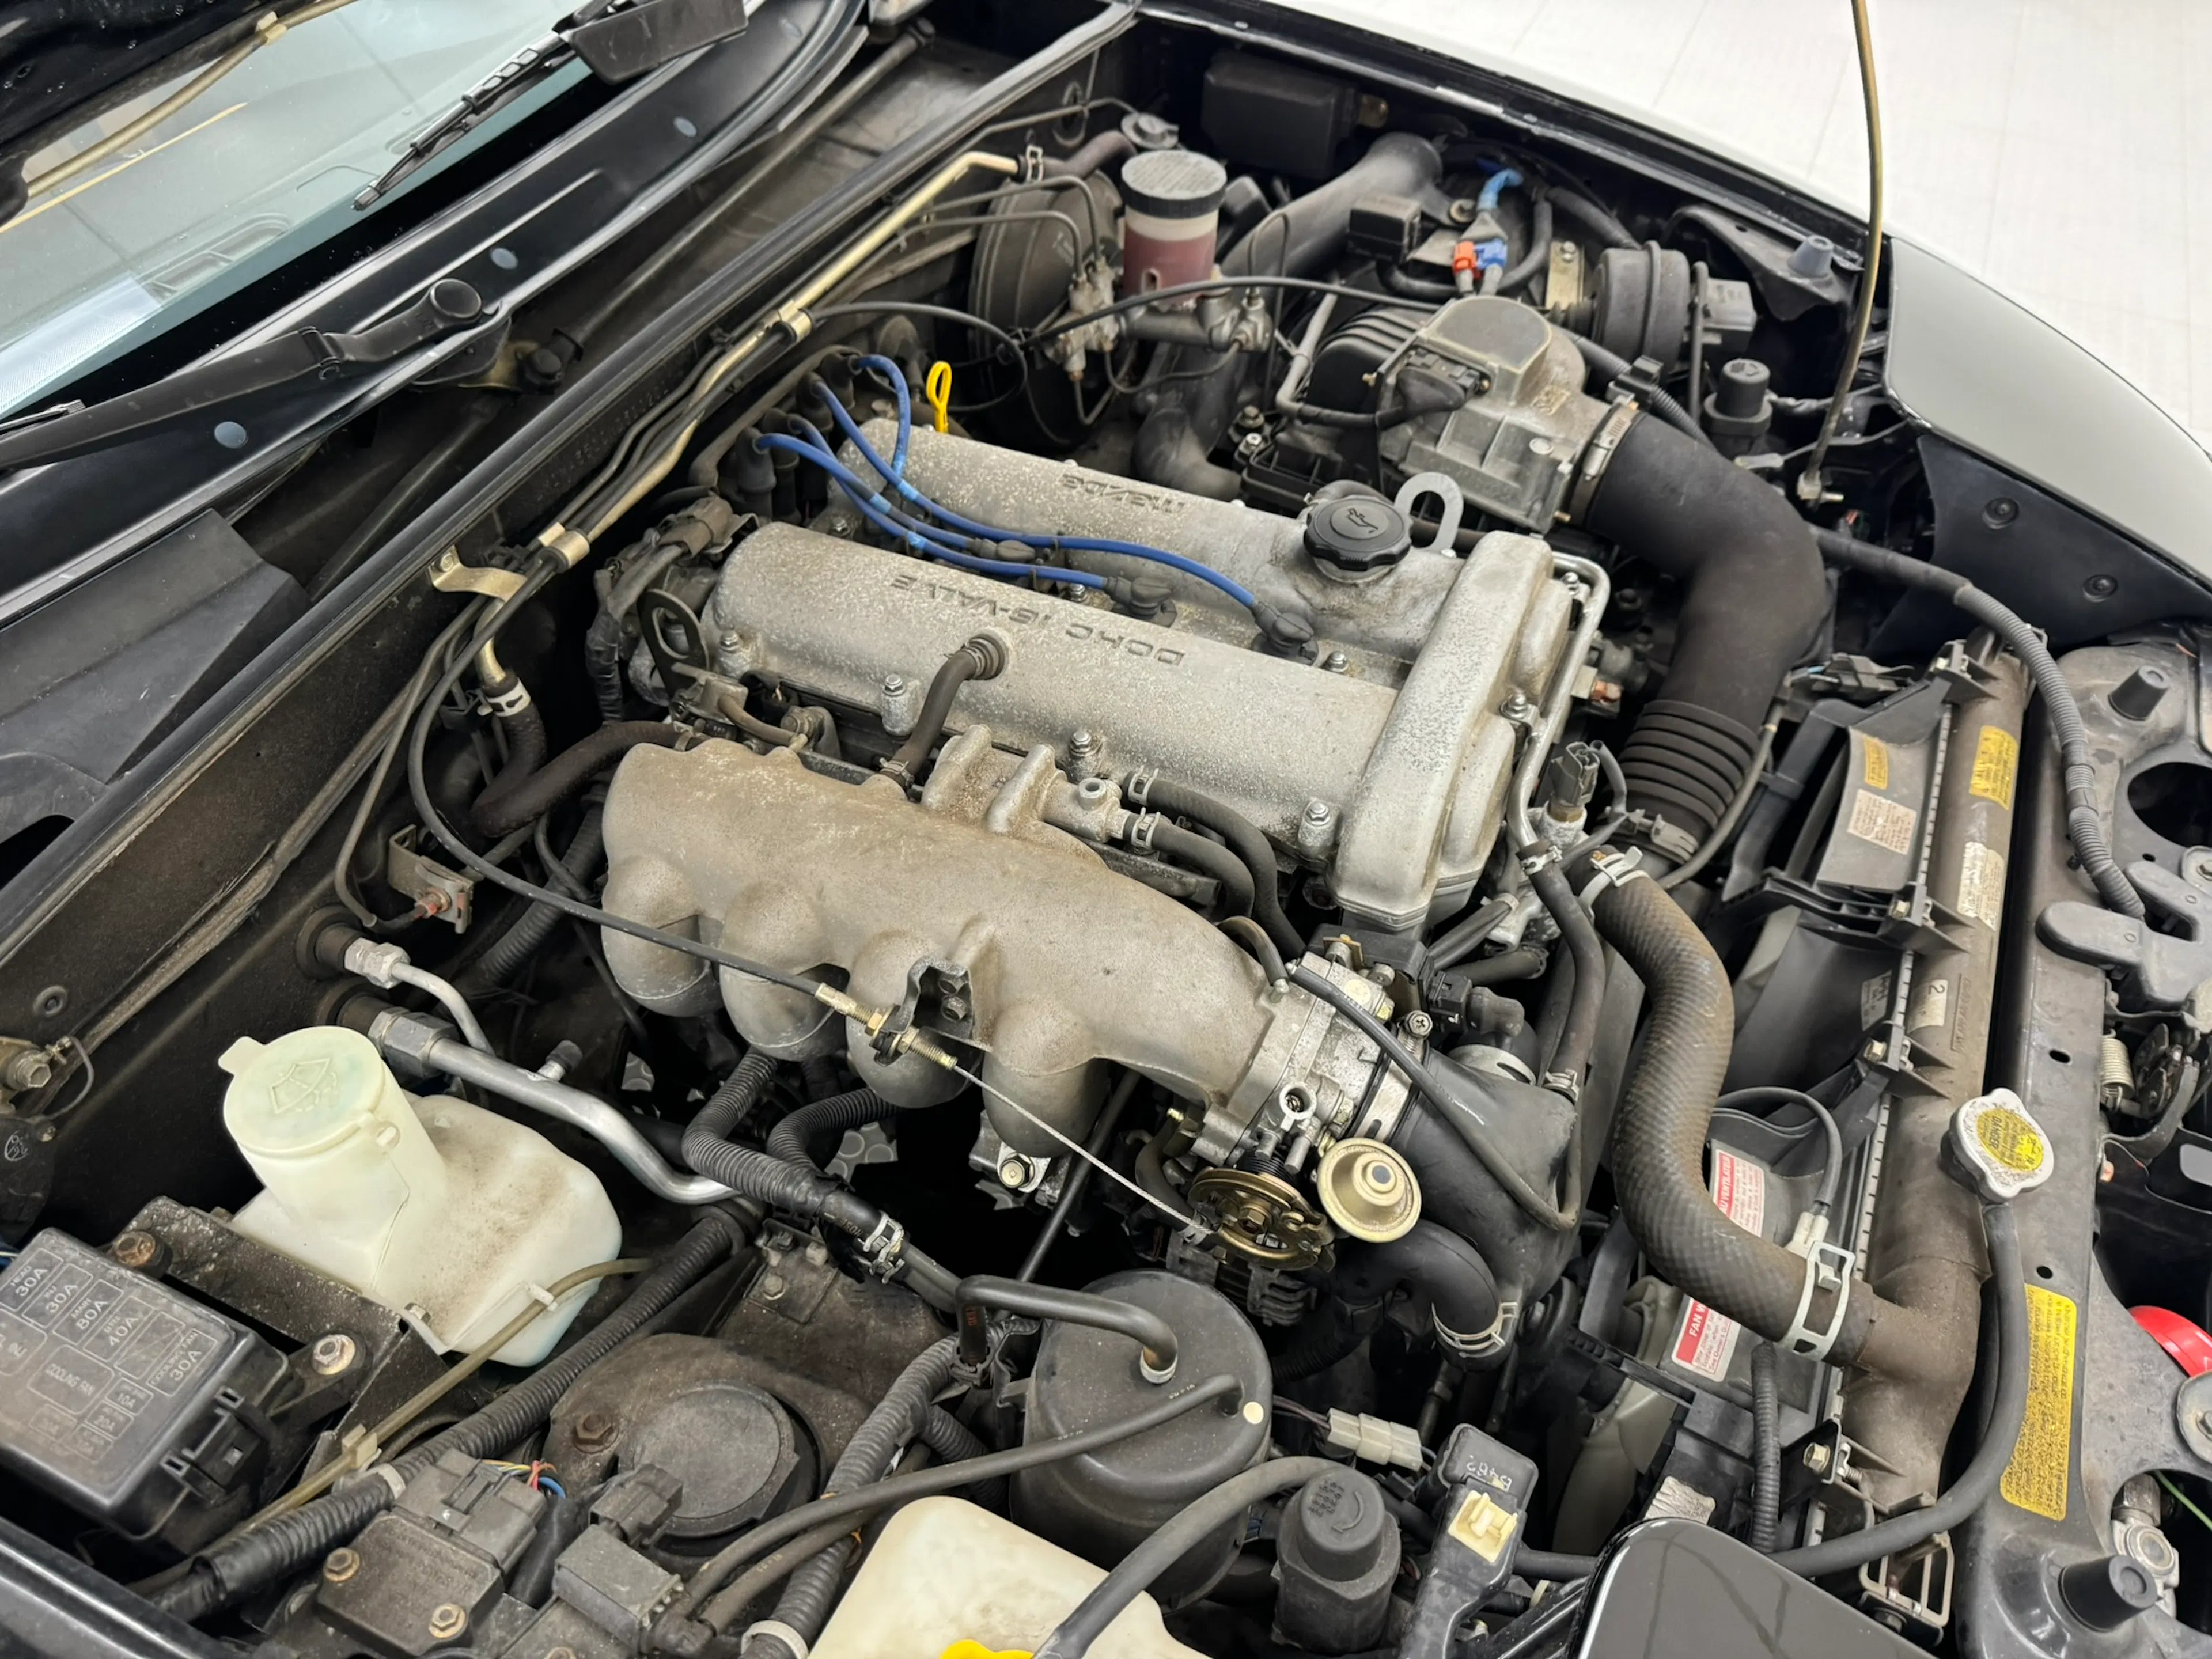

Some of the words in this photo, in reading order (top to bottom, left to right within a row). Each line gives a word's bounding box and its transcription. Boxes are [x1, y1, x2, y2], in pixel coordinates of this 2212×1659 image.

[1065, 622, 1187, 666] DOHC
[1929, 984, 1945, 995] 2
[1988, 1115, 2003, 1149] DANGER
[15, 1268, 48, 1296] 30A
[46, 1285, 78, 1313] 30A
[71, 1298, 92, 1319] MAIN
[76, 1301, 108, 1330] 80A
[1689, 1313, 1703, 1337] FAN
[109, 1317, 139, 1346] 40A
[169, 1351, 202, 1381] 30A
